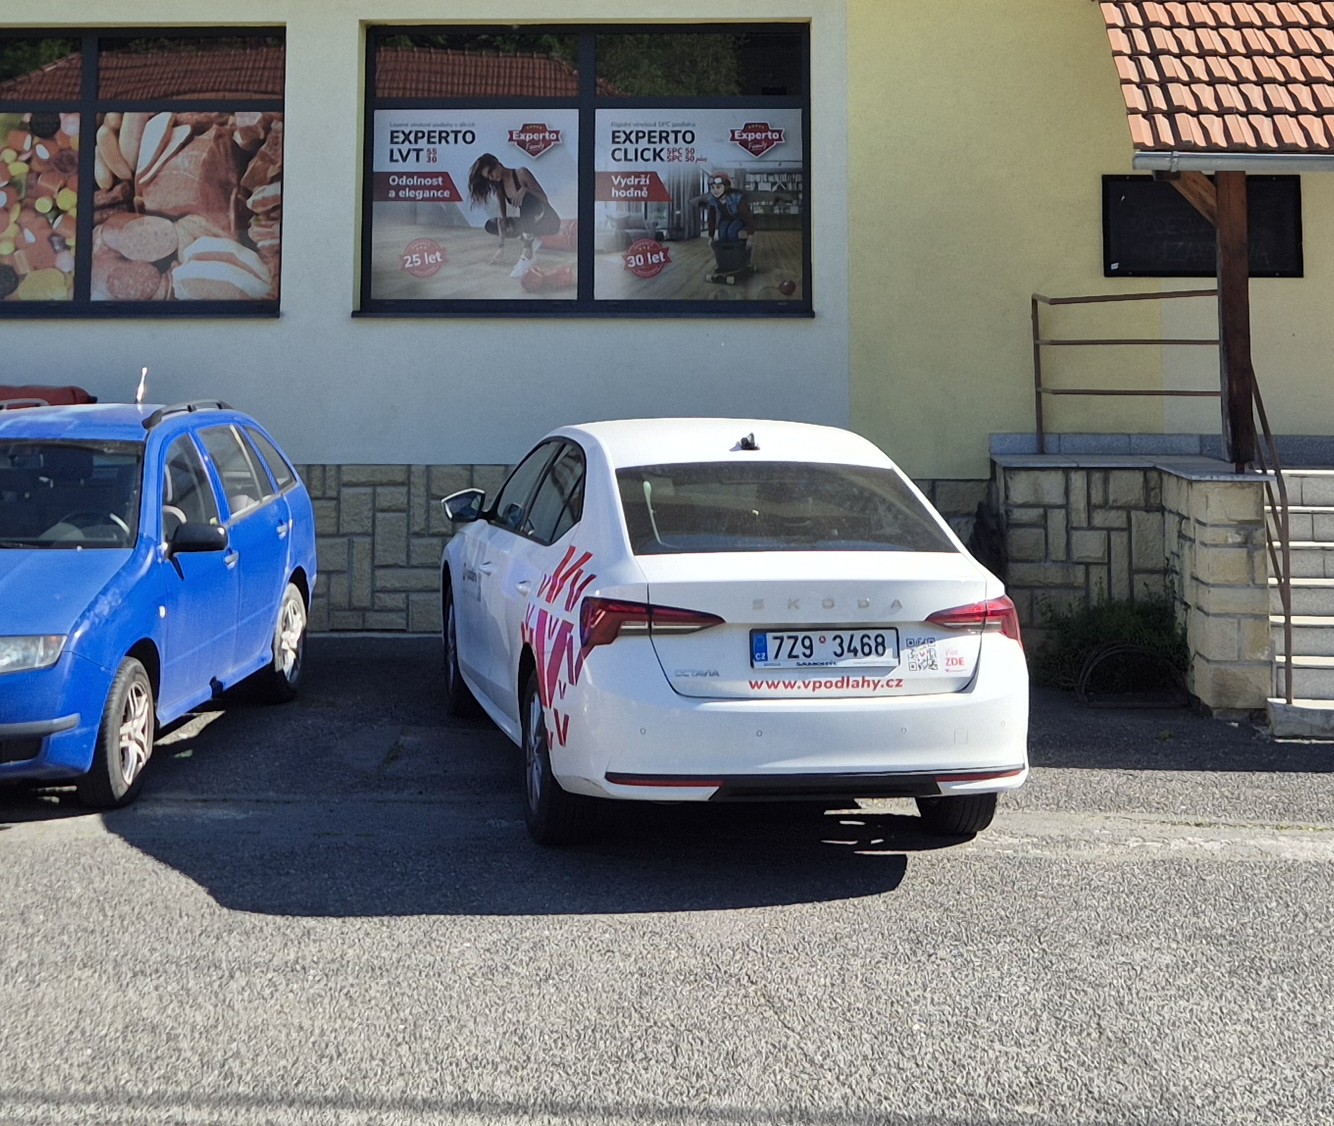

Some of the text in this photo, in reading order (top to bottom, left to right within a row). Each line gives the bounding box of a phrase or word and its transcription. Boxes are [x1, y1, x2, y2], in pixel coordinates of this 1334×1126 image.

[389, 130, 476, 145] EXPERTO
[512, 131, 557, 142] Experto
[611, 130, 695, 145] EXPERTO
[734, 130, 780, 141] Experto
[389, 148, 424, 163] LVT
[611, 147, 666, 162] CLICK
[389, 175, 444, 186] Odolnost
[611, 175, 651, 187] Vydrží
[388, 188, 451, 200] a elegance
[611, 187, 649, 198] hodně
[403, 251, 443, 268] 25 let
[627, 251, 666, 268] 30 let
[771, 633, 888, 661] 7Z9 3468
[754, 652, 767, 661] CZ
[944, 657, 966, 667] ZDE
[748, 676, 904, 692] www.vpodlahy.cz
